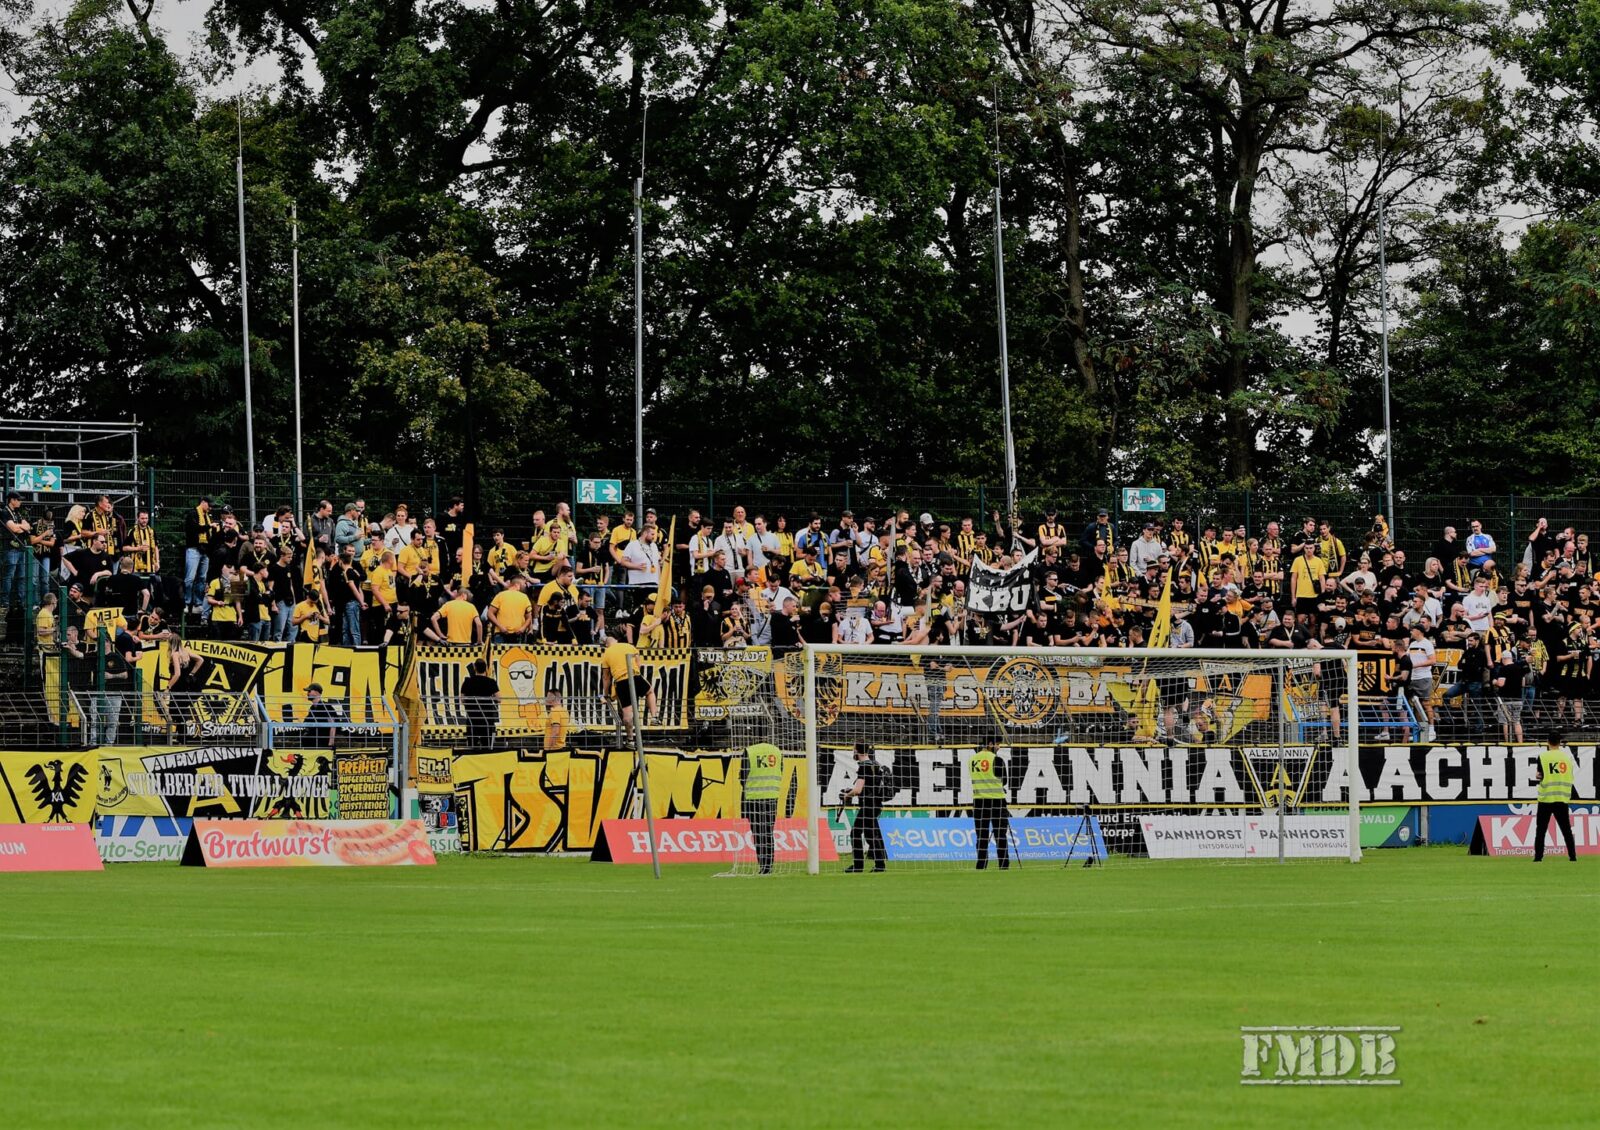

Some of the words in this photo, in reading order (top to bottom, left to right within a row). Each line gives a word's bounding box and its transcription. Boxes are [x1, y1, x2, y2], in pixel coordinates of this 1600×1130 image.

[968, 584, 1031, 612] KBU
[184, 641, 258, 665] ALEMANNIA
[727, 651, 768, 662] STADT
[205, 663, 231, 690] A
[699, 706, 725, 717] UND
[727, 704, 764, 716] VEREI
[1249, 748, 1311, 758] ALEMNNIA
[338, 759, 386, 774] FREIHEIT
[756, 754, 777, 769] K9
[971, 759, 990, 773] K9
[1548, 761, 1568, 775] K9
[126, 772, 225, 796] STOLBERGER
[339, 783, 387, 794] SICHERHEIT
[1097, 812, 1119, 823] und
[905, 828, 1020, 848] eurons
[1154, 829, 1242, 840] PANNHORST
[98, 840, 184, 858] uto-Servi
[204, 828, 333, 859] Bratwurst
[627, 831, 809, 853] HAGEDORN
[1495, 847, 1539, 856] TransCarg
